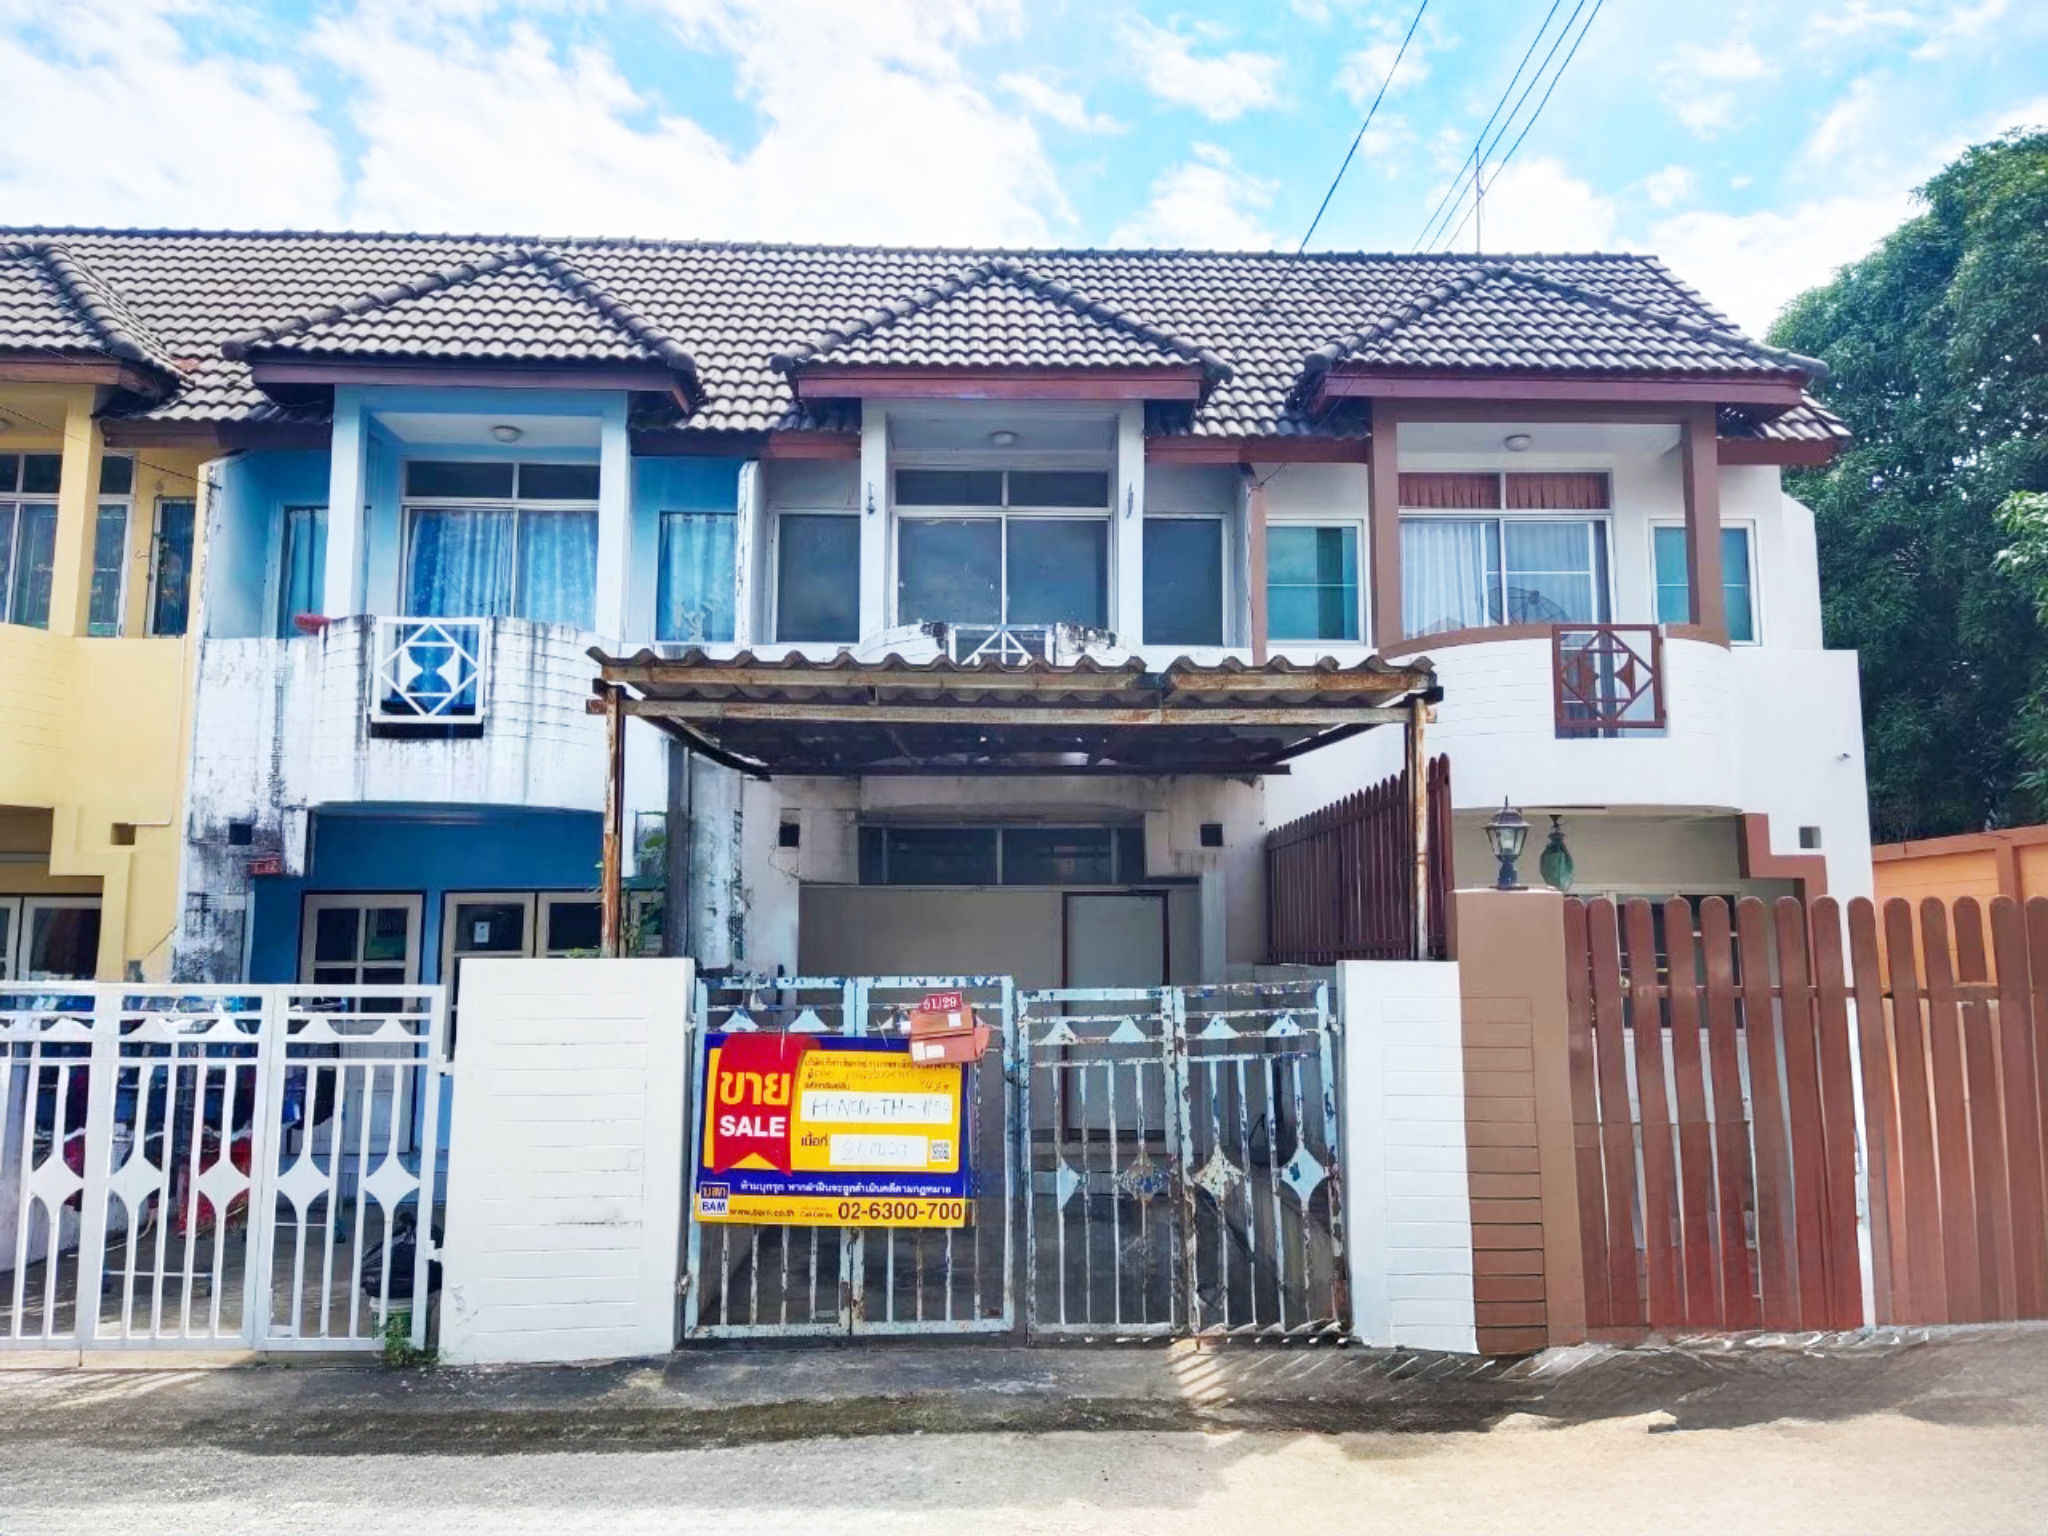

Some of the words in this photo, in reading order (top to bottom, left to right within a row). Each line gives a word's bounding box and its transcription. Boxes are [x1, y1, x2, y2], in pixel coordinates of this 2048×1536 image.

[720, 1071, 791, 1105] ขาย
[719, 1115, 786, 1137] SALE
[702, 1201, 726, 1212] BAM
[838, 1202, 963, 1220] 02-6300-700
